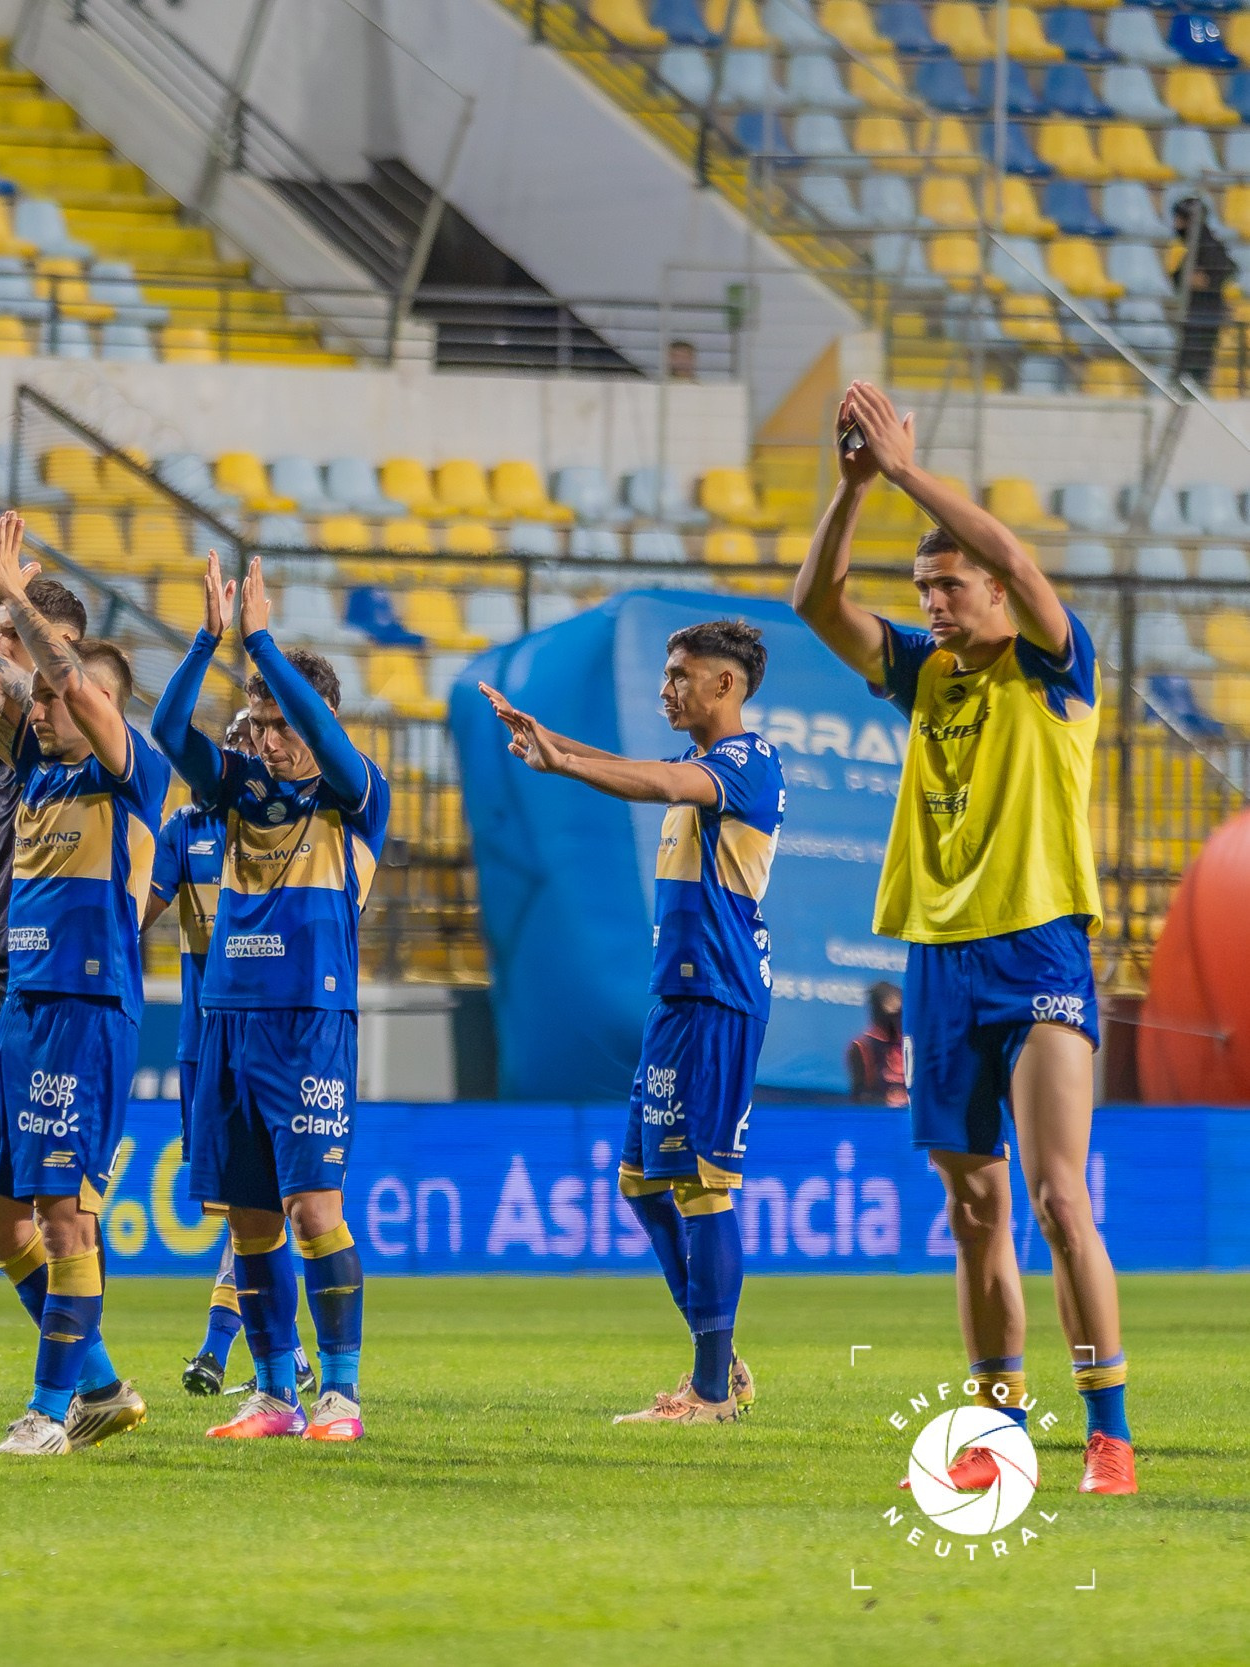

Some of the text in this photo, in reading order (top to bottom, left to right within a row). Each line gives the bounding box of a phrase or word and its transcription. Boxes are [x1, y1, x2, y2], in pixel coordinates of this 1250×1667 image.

[226, 946, 284, 956] ROYAL.COM
[228, 936, 280, 946] APUESTAS
[17, 1110, 79, 1138] Claro
[291, 1112, 349, 1138] Claro
[643, 1099, 685, 1126] Claro
[366, 1175, 463, 1257] en
[486, 1140, 902, 1258] Asisncia
